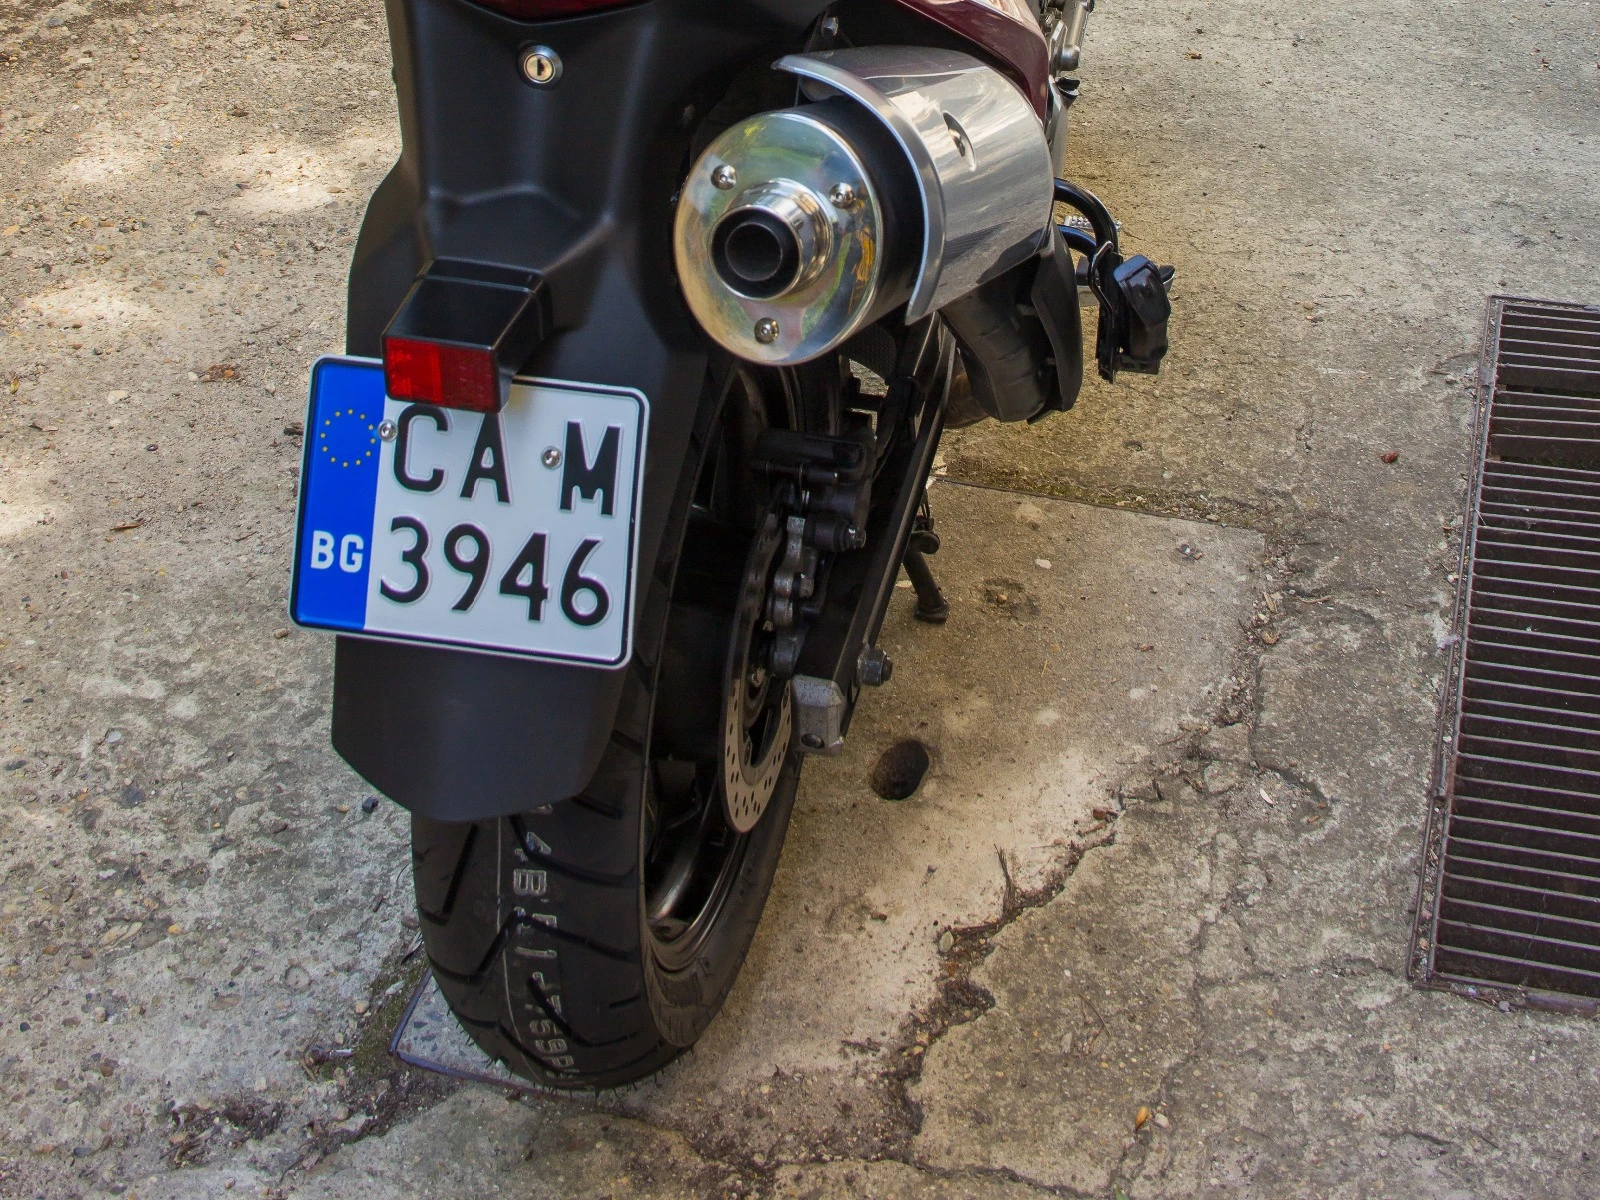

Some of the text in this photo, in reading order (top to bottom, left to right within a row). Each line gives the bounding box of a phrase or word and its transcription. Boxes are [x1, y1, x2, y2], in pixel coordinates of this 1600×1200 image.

[393, 402, 621, 517] CA M
[310, 530, 364, 574] BG
[380, 515, 610, 627] 3946
